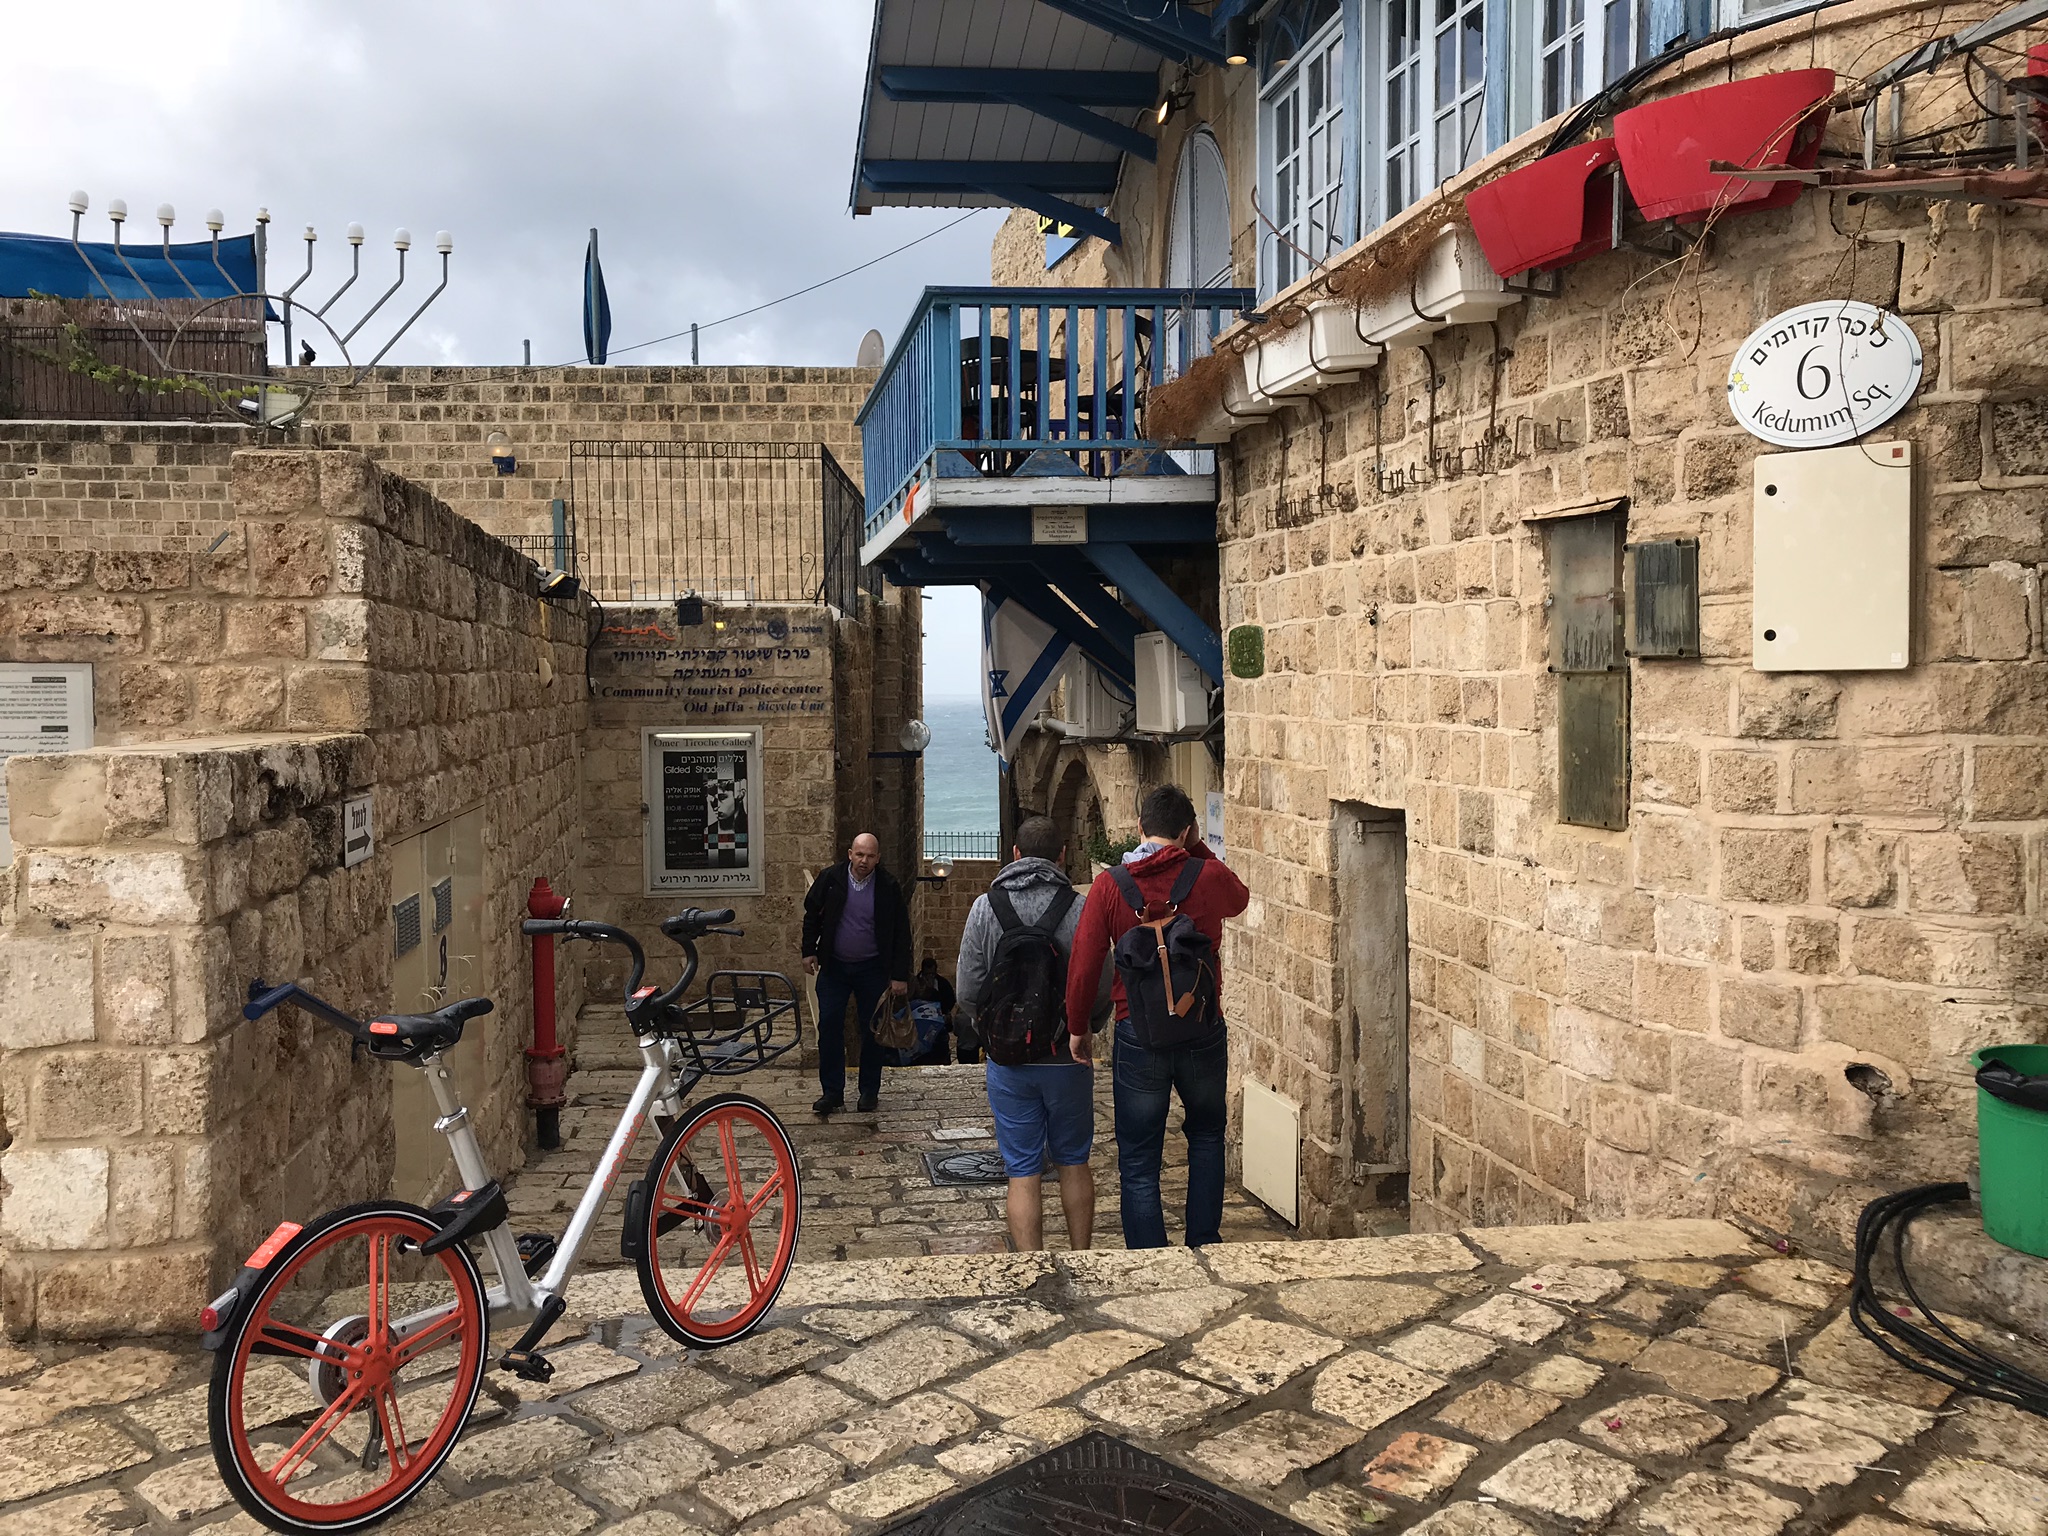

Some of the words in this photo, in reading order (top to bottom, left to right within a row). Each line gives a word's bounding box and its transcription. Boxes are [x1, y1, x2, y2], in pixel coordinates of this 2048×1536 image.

[1749, 316, 1830, 366] קדומים
[1796, 344, 1832, 400] 6
[1752, 401, 1852, 433] Kedumim
[1852, 382, 1893, 411] Sq.
[732, 648, 774, 660] שיטור
[777, 648, 811, 660] מרכז
[673, 668, 731, 681] העתיקה
[734, 668, 753, 679] יפו
[602, 685, 683, 698] Community
[687, 685, 734, 697] tourist
[738, 684, 779, 698] police
[782, 684, 824, 695] center
[684, 702, 708, 714] Old
[757, 701, 797, 713] Bicycle
[800, 701, 825, 712] Unit
[654, 739, 680, 747] Omer
[683, 738, 719, 747] Tiroche
[722, 738, 754, 747] Gallery
[681, 755, 716, 764] מוזהבים
[718, 754, 745, 763] צללים
[664, 765, 691, 774] Gilded
[351, 803, 367, 830] לנמל
[660, 875, 691, 883] תירוש
[693, 874, 719, 883] עומר
[722, 873, 751, 882] גלריה
[603, 1112, 645, 1193] mobike
